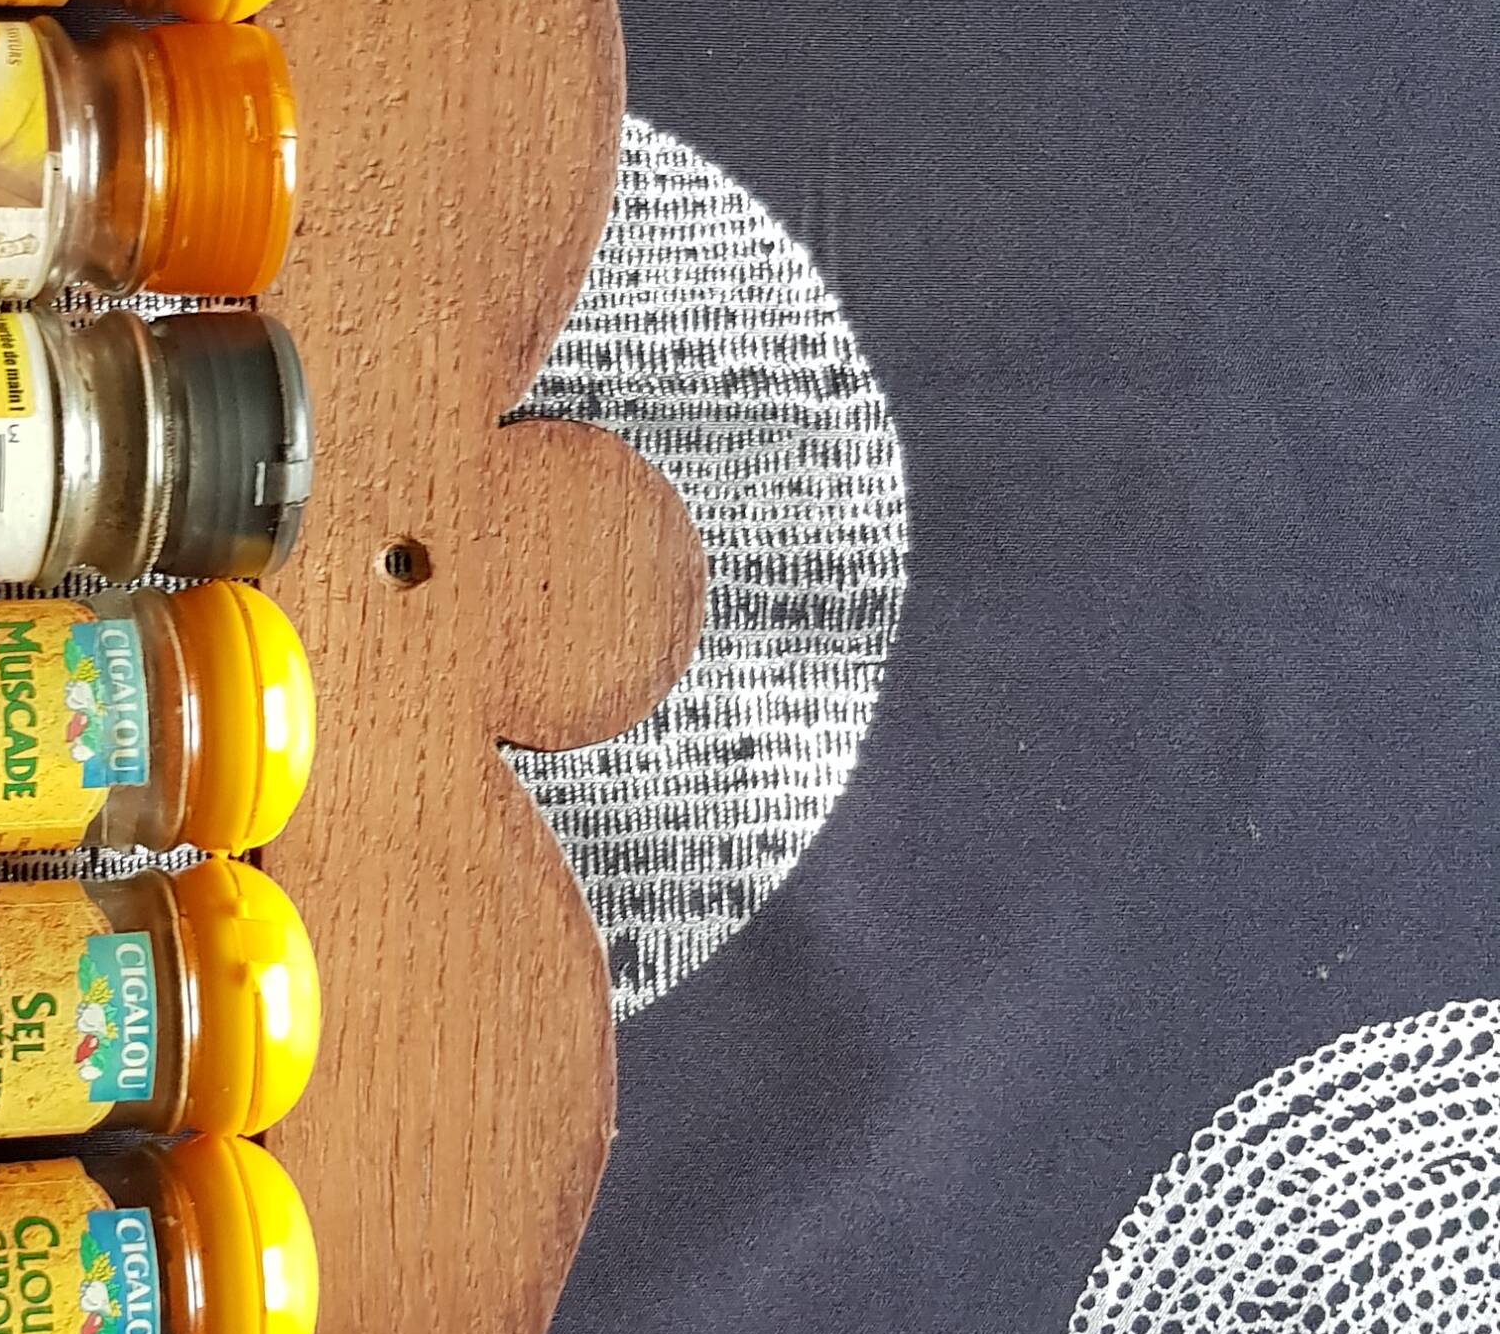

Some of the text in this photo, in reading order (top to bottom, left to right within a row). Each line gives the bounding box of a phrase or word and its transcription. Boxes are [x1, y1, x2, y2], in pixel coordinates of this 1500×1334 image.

[4, 368, 23, 404] main
[98, 627, 138, 772] CIGALOU
[9, 992, 57, 1062] SEL
[114, 942, 150, 1089] CIGALOU
[12, 1216, 60, 1334] CLOU
